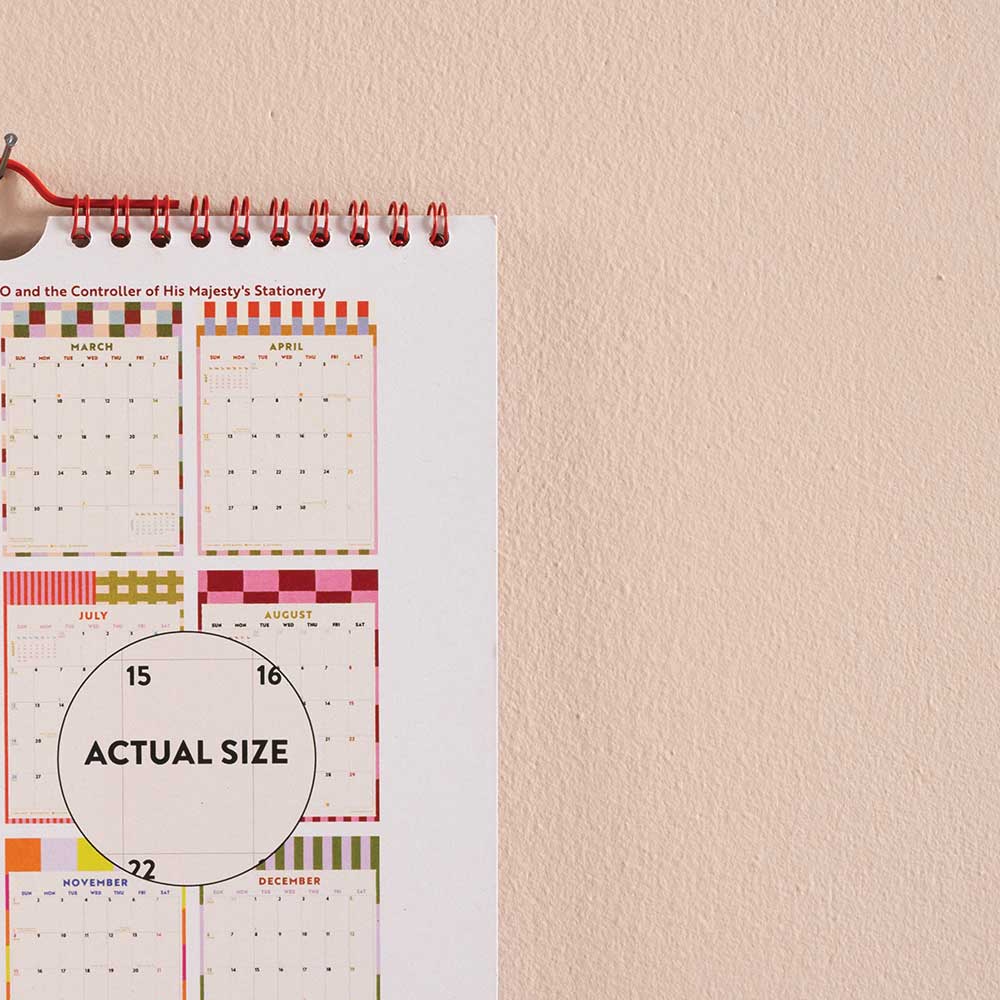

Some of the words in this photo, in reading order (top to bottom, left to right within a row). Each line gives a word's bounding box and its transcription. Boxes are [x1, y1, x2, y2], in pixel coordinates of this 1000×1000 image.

[16, 286, 40, 296] and
[45, 286, 67, 296] the
[71, 286, 141, 296] Controller
[146, 285, 159, 296] of
[164, 286, 184, 296] His
[190, 285, 250, 299] Majesty's
[255, 285, 326, 299] Stationery
[71, 343, 112, 351] MARCH
[79, 612, 108, 620] JULY
[264, 610, 312, 619] AUGUST
[126, 666, 151, 686] 15
[256, 664, 282, 685] 16
[84, 740, 212, 765] ACTUAL
[222, 740, 288, 764] SIZE
[259, 877, 320, 885] DECEMBER
